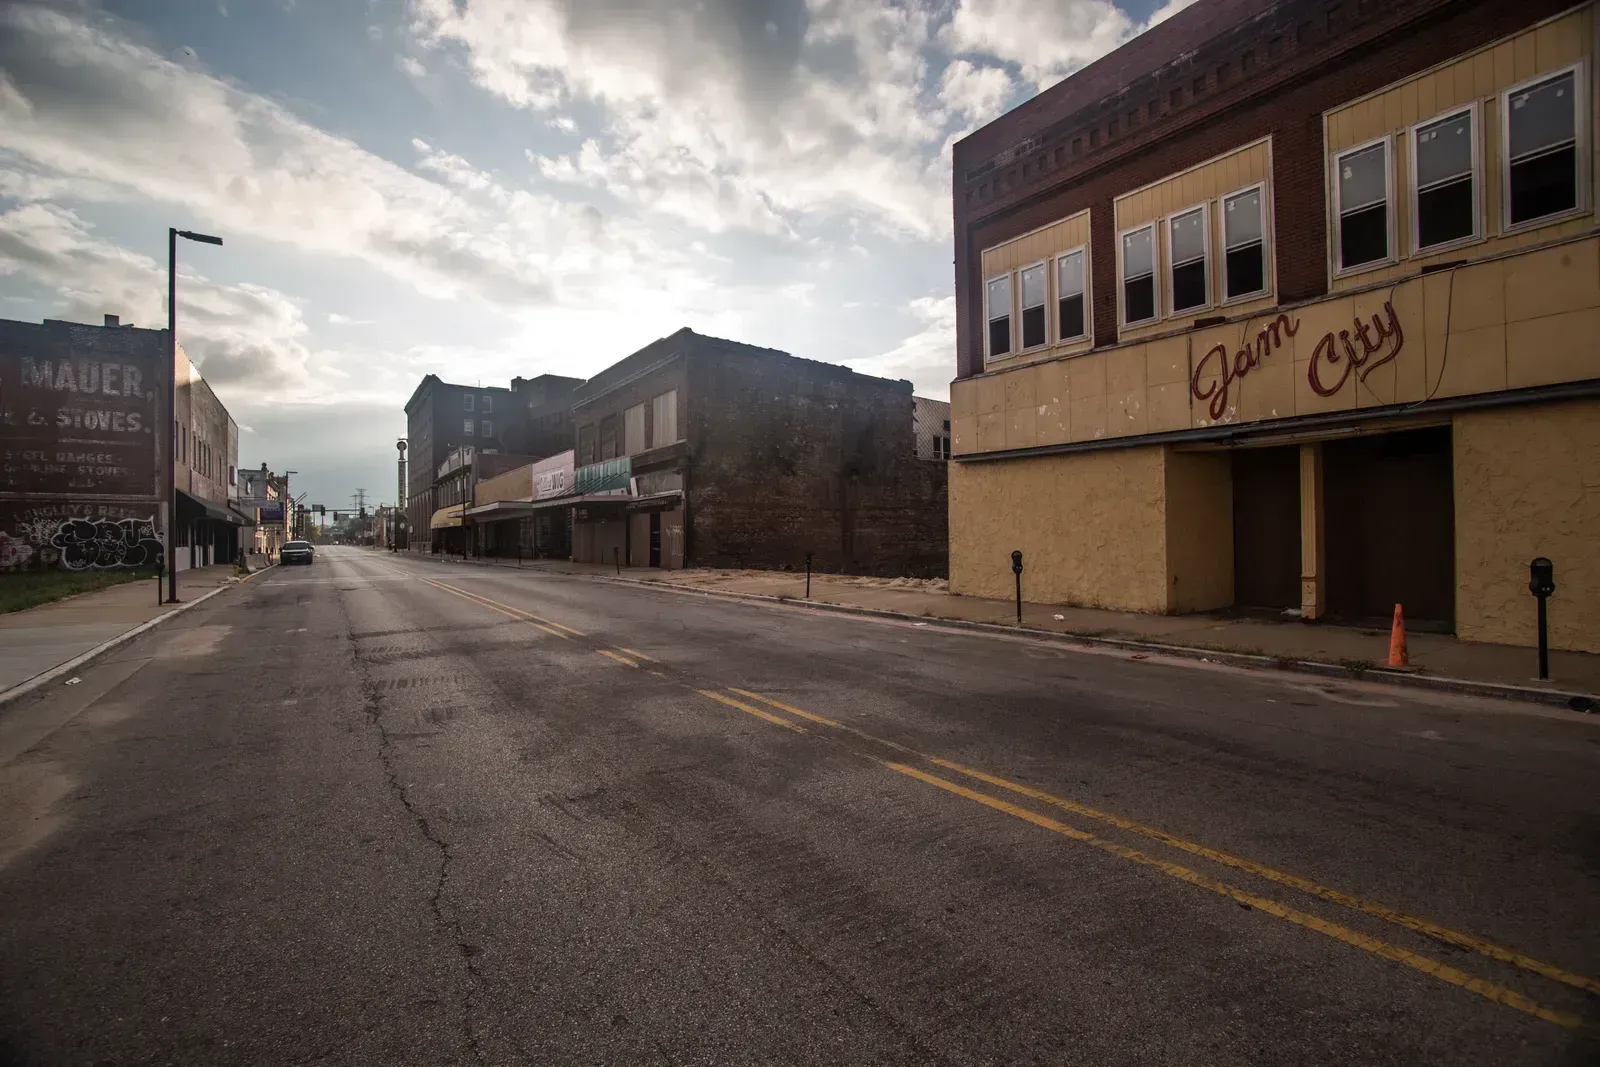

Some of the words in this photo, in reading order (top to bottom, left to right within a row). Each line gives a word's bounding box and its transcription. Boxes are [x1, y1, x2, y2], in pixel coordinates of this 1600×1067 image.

[1193, 314, 1300, 420] Jam
[1308, 301, 1404, 397] City
[56, 408, 151, 433] STOVES.
[5, 451, 48, 461] SEEL
